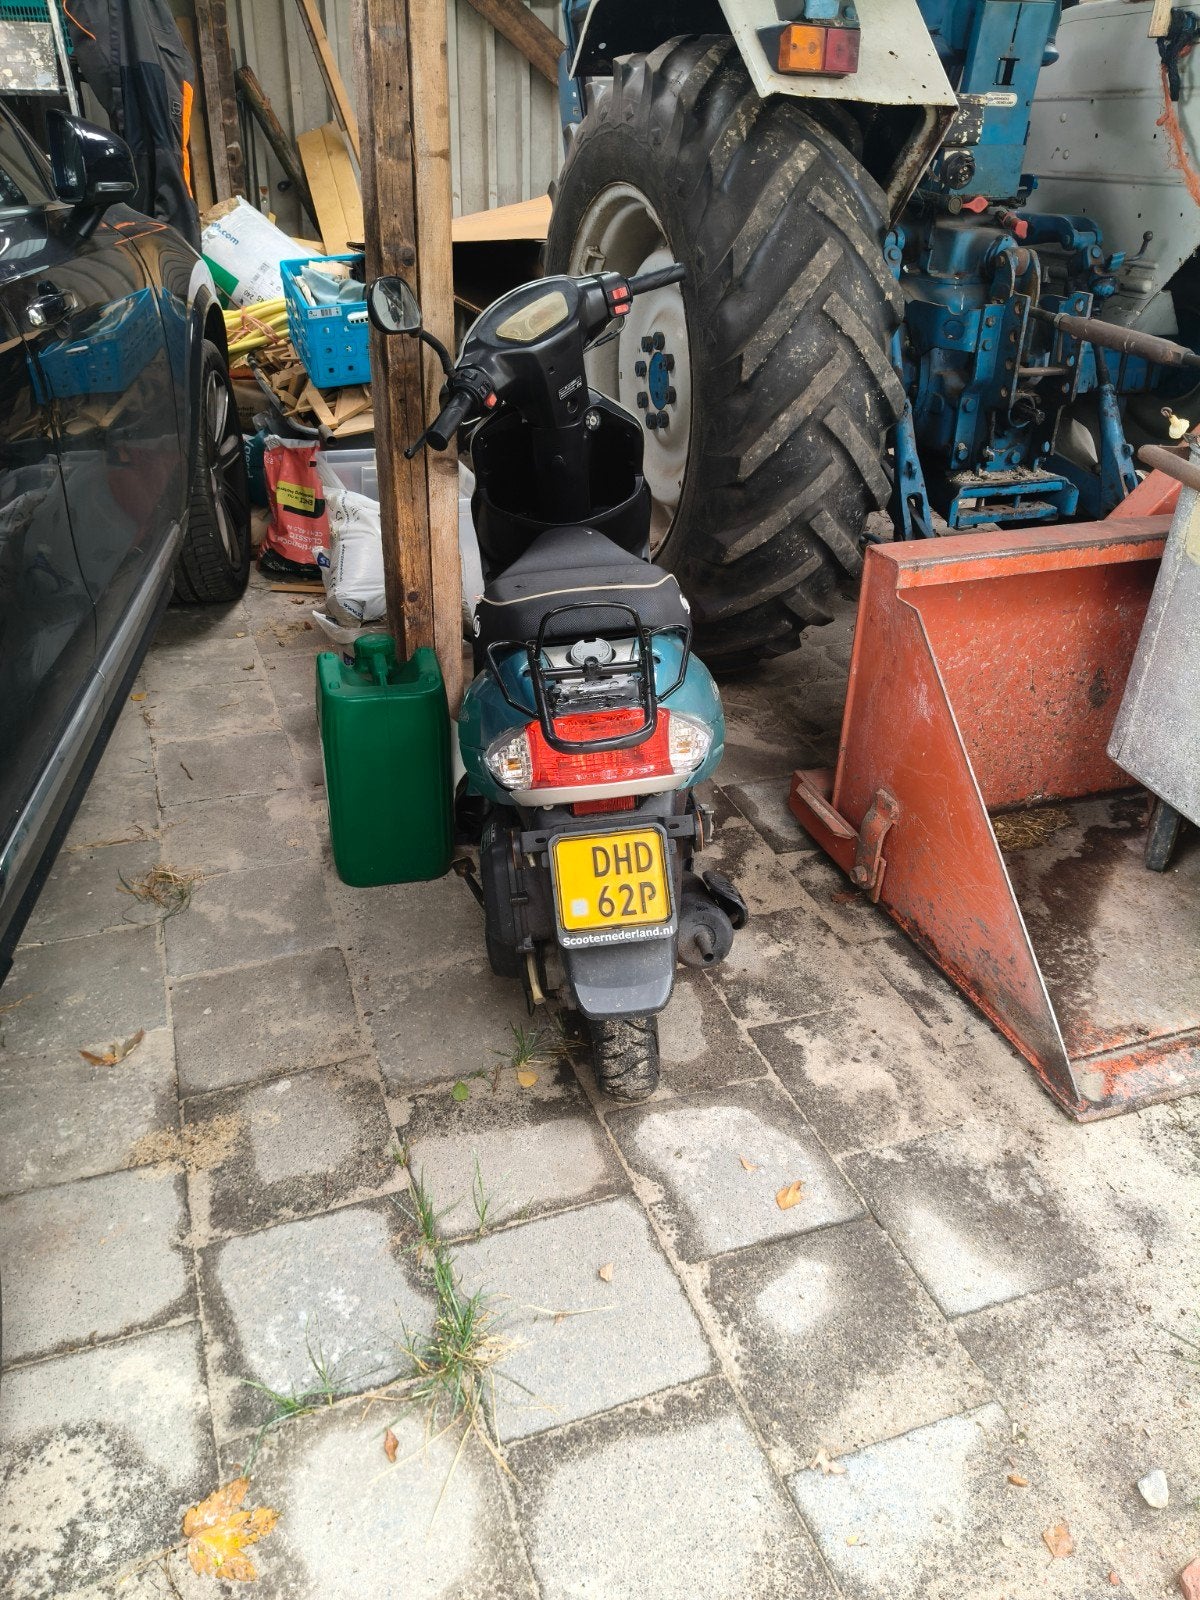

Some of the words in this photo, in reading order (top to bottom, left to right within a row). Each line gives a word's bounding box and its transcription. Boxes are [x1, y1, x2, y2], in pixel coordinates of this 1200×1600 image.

[299, 497, 313, 506] ENCI
[288, 531, 323, 545] CLASSIC
[592, 841, 653, 878] DHD
[598, 881, 657, 917] 62P
[563, 926, 674, 946] Scooternederland.nl
